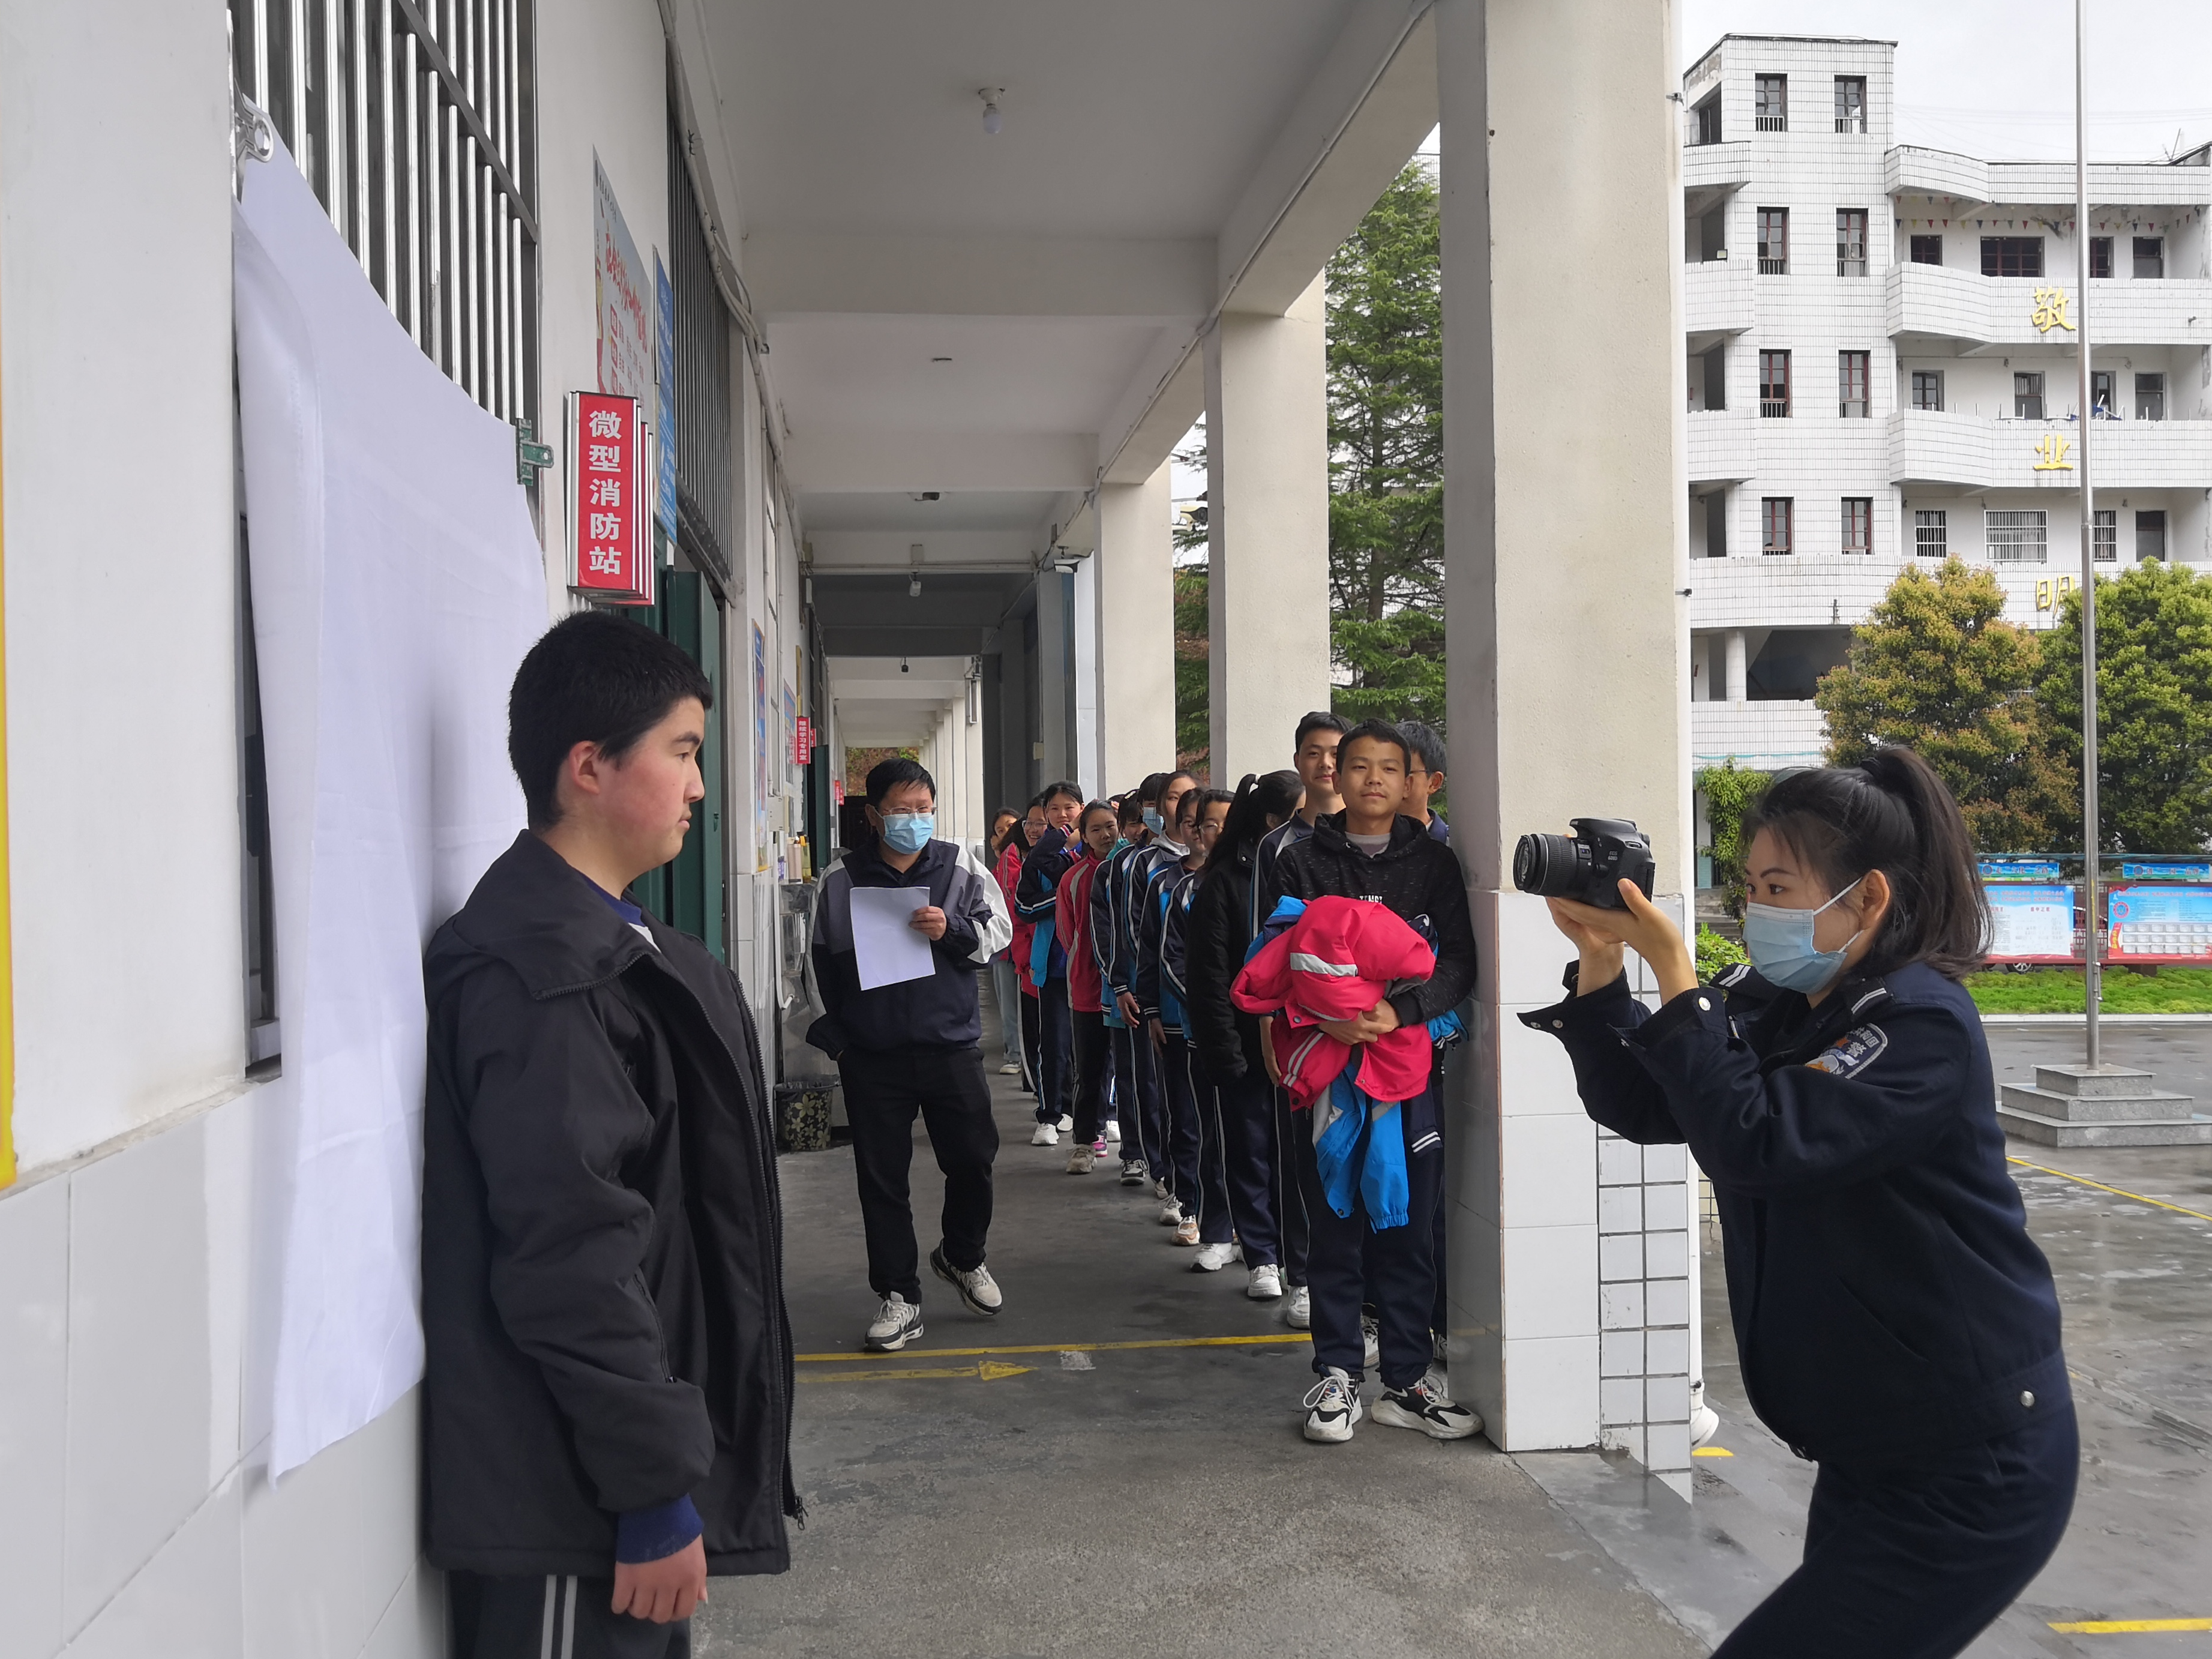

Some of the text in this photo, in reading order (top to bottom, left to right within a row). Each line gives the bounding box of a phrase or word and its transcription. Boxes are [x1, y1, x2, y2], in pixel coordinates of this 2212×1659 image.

[2032, 287, 2076, 333] 敬
[2033, 435, 2073, 471] 业
[589, 411, 622, 575] 微型消防站
